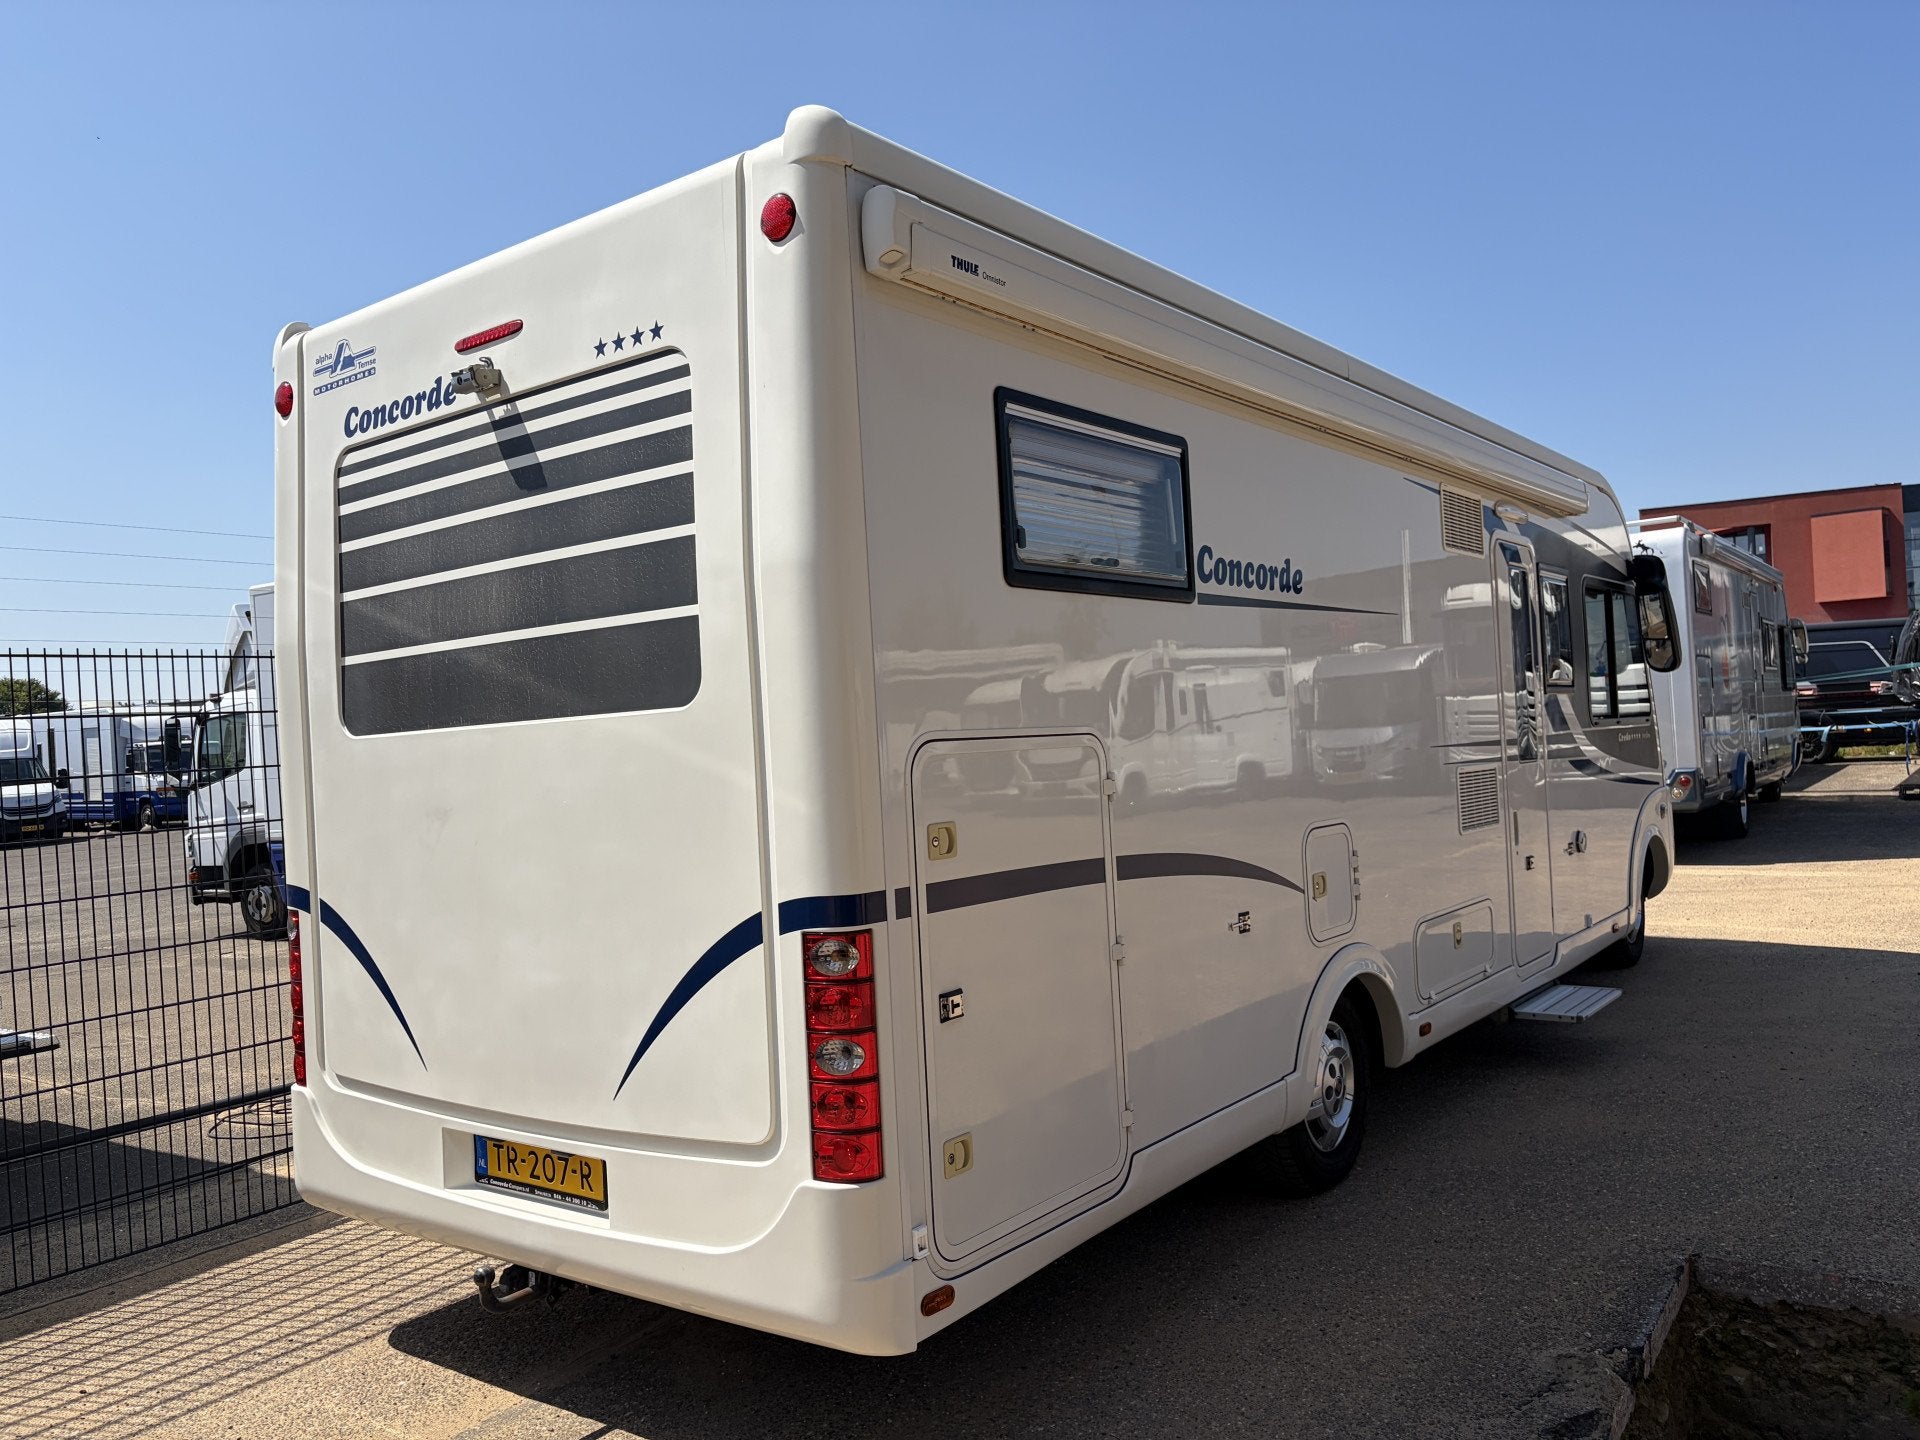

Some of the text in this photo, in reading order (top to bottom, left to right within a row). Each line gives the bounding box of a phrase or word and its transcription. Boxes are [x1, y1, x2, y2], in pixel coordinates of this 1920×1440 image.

[951, 254, 979, 277] THULE
[315, 353, 333, 365] alpha
[357, 358, 377, 370] Temse
[314, 368, 376, 395] MOTORHOMES
[344, 375, 457, 439] Concorde
[1197, 544, 1303, 595] Concorde
[478, 1157, 487, 1168] NL
[492, 1142, 594, 1193] TR-207-R
